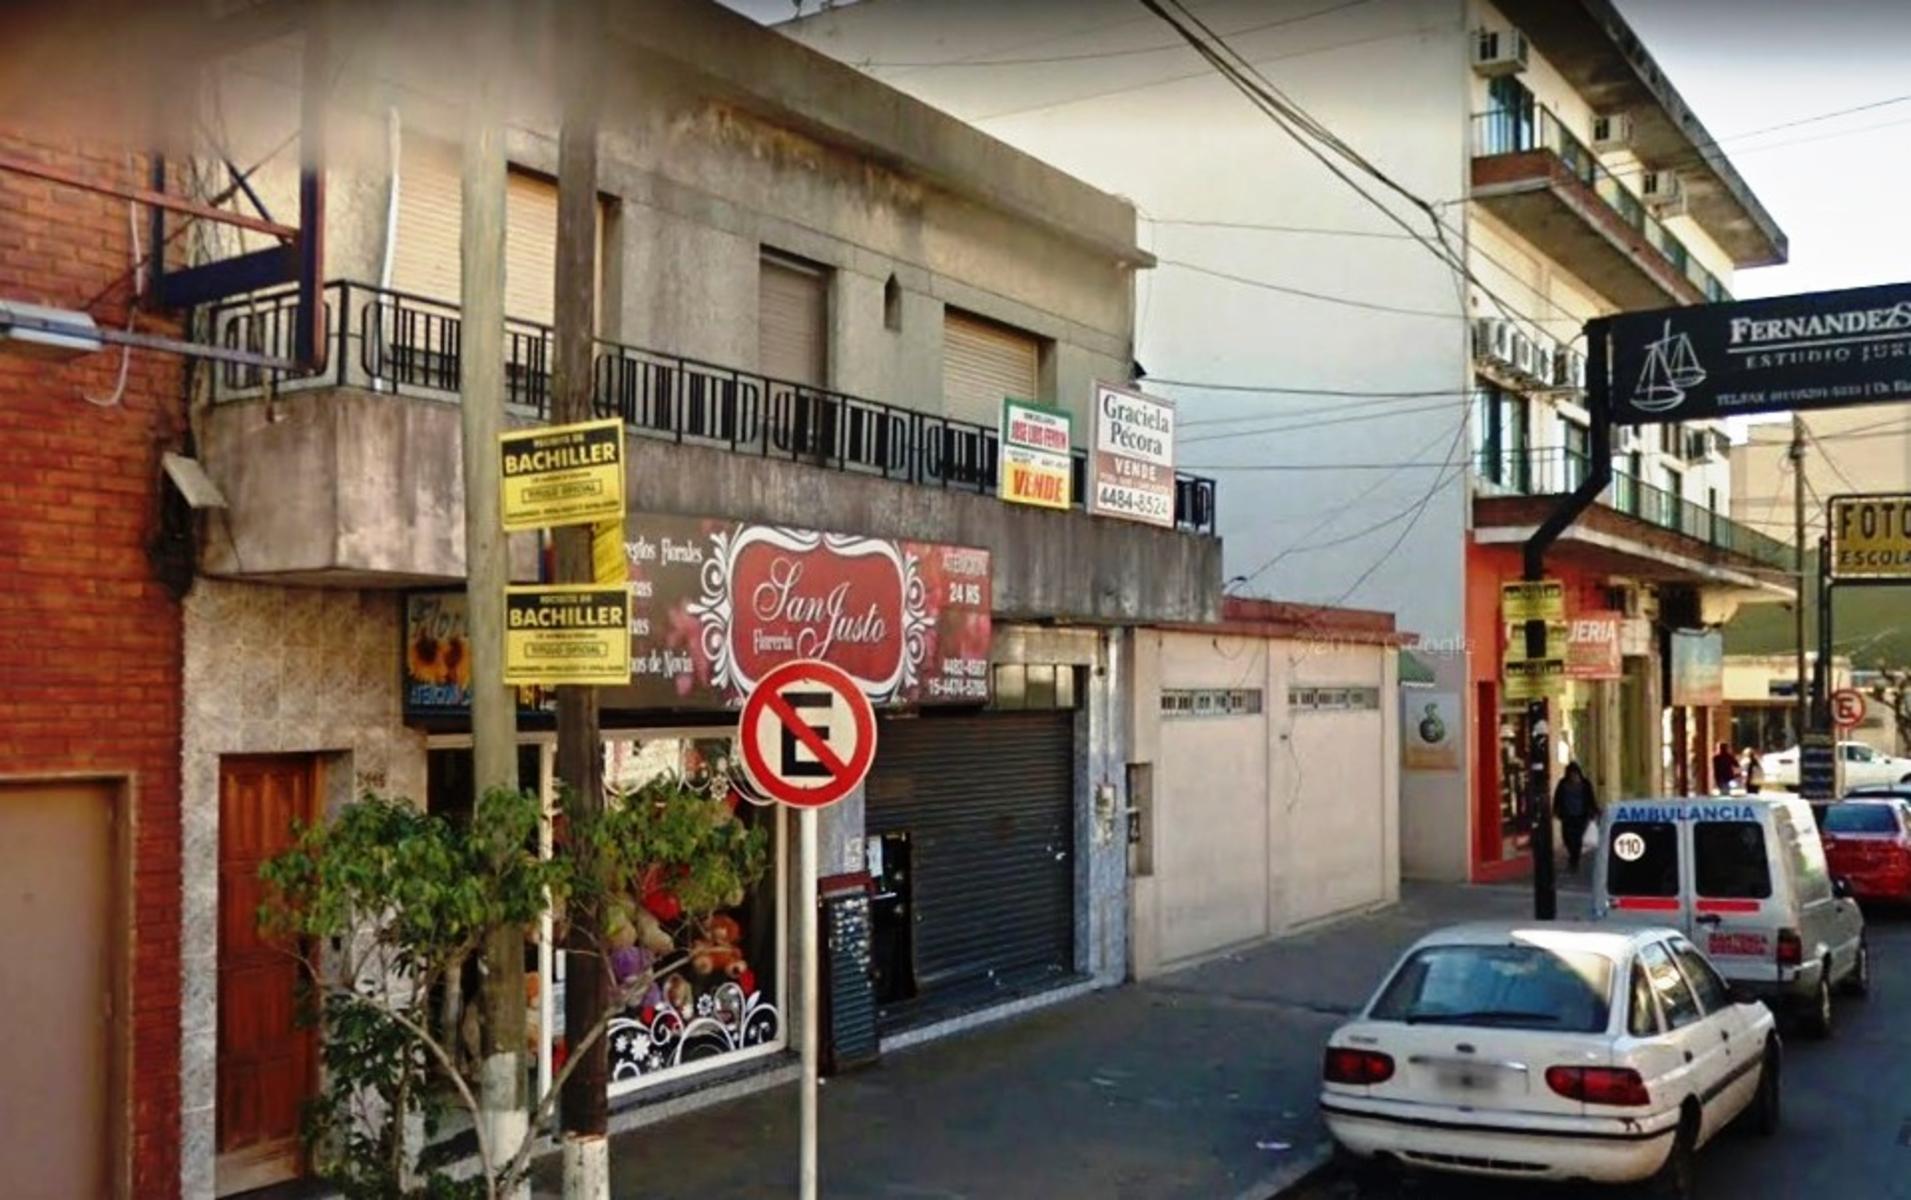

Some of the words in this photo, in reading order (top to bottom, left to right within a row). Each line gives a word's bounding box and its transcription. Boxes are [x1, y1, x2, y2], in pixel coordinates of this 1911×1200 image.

[1103, 394, 1170, 434] Graciela
[1110, 421, 1163, 456] Pécora
[504, 442, 616, 474] BACHILLER
[1114, 457, 1157, 481] VENDE
[1013, 469, 1064, 503] VENDE
[752, 556, 824, 621] San
[797, 582, 886, 660] Justo
[949, 582, 963, 603] 24
[510, 606, 623, 627] BACHILLER
[782, 692, 835, 776] E
[1615, 805, 1755, 822] AMBULANCIA
[1618, 838, 1641, 856] 110
